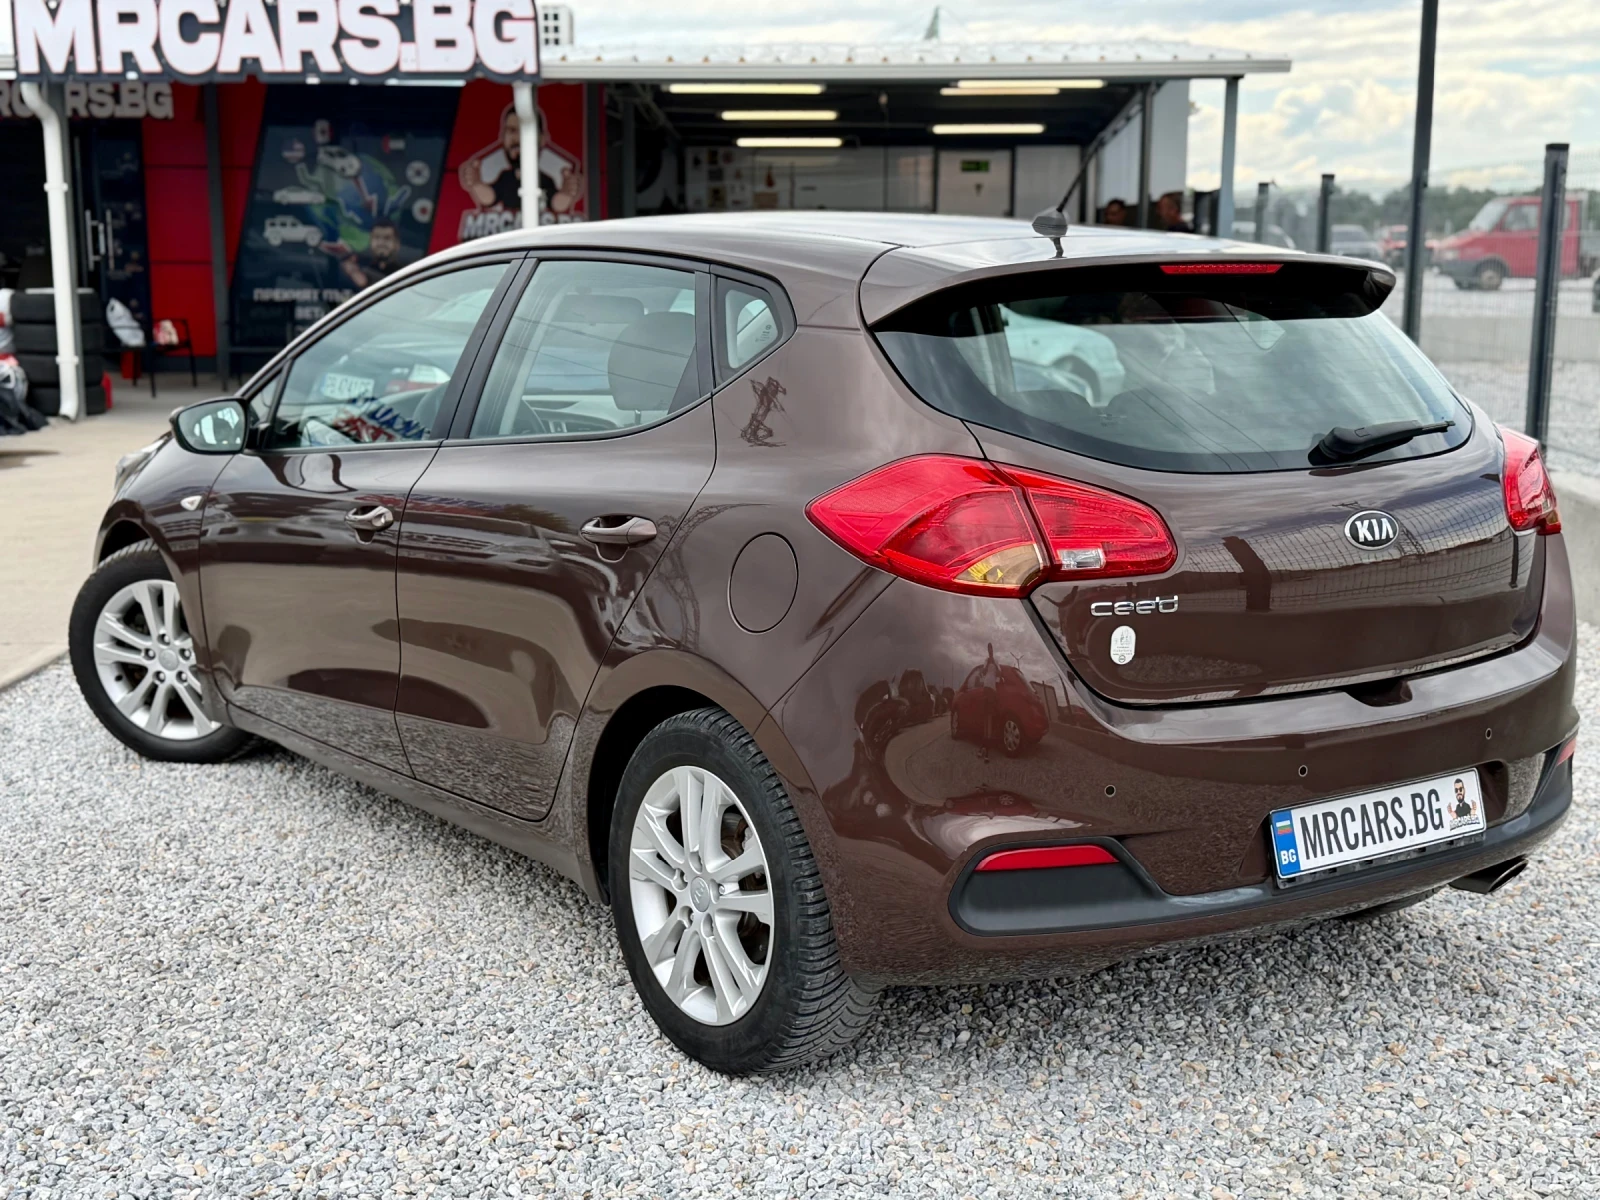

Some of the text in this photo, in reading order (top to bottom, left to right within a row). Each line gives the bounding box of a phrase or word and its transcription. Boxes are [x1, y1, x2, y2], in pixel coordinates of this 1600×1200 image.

[14, 0, 538, 74] MRCARS.BG
[1355, 517, 1394, 543] KIA
[1300, 788, 1445, 861] MRCARS.BG
[1280, 848, 1297, 865] BG
